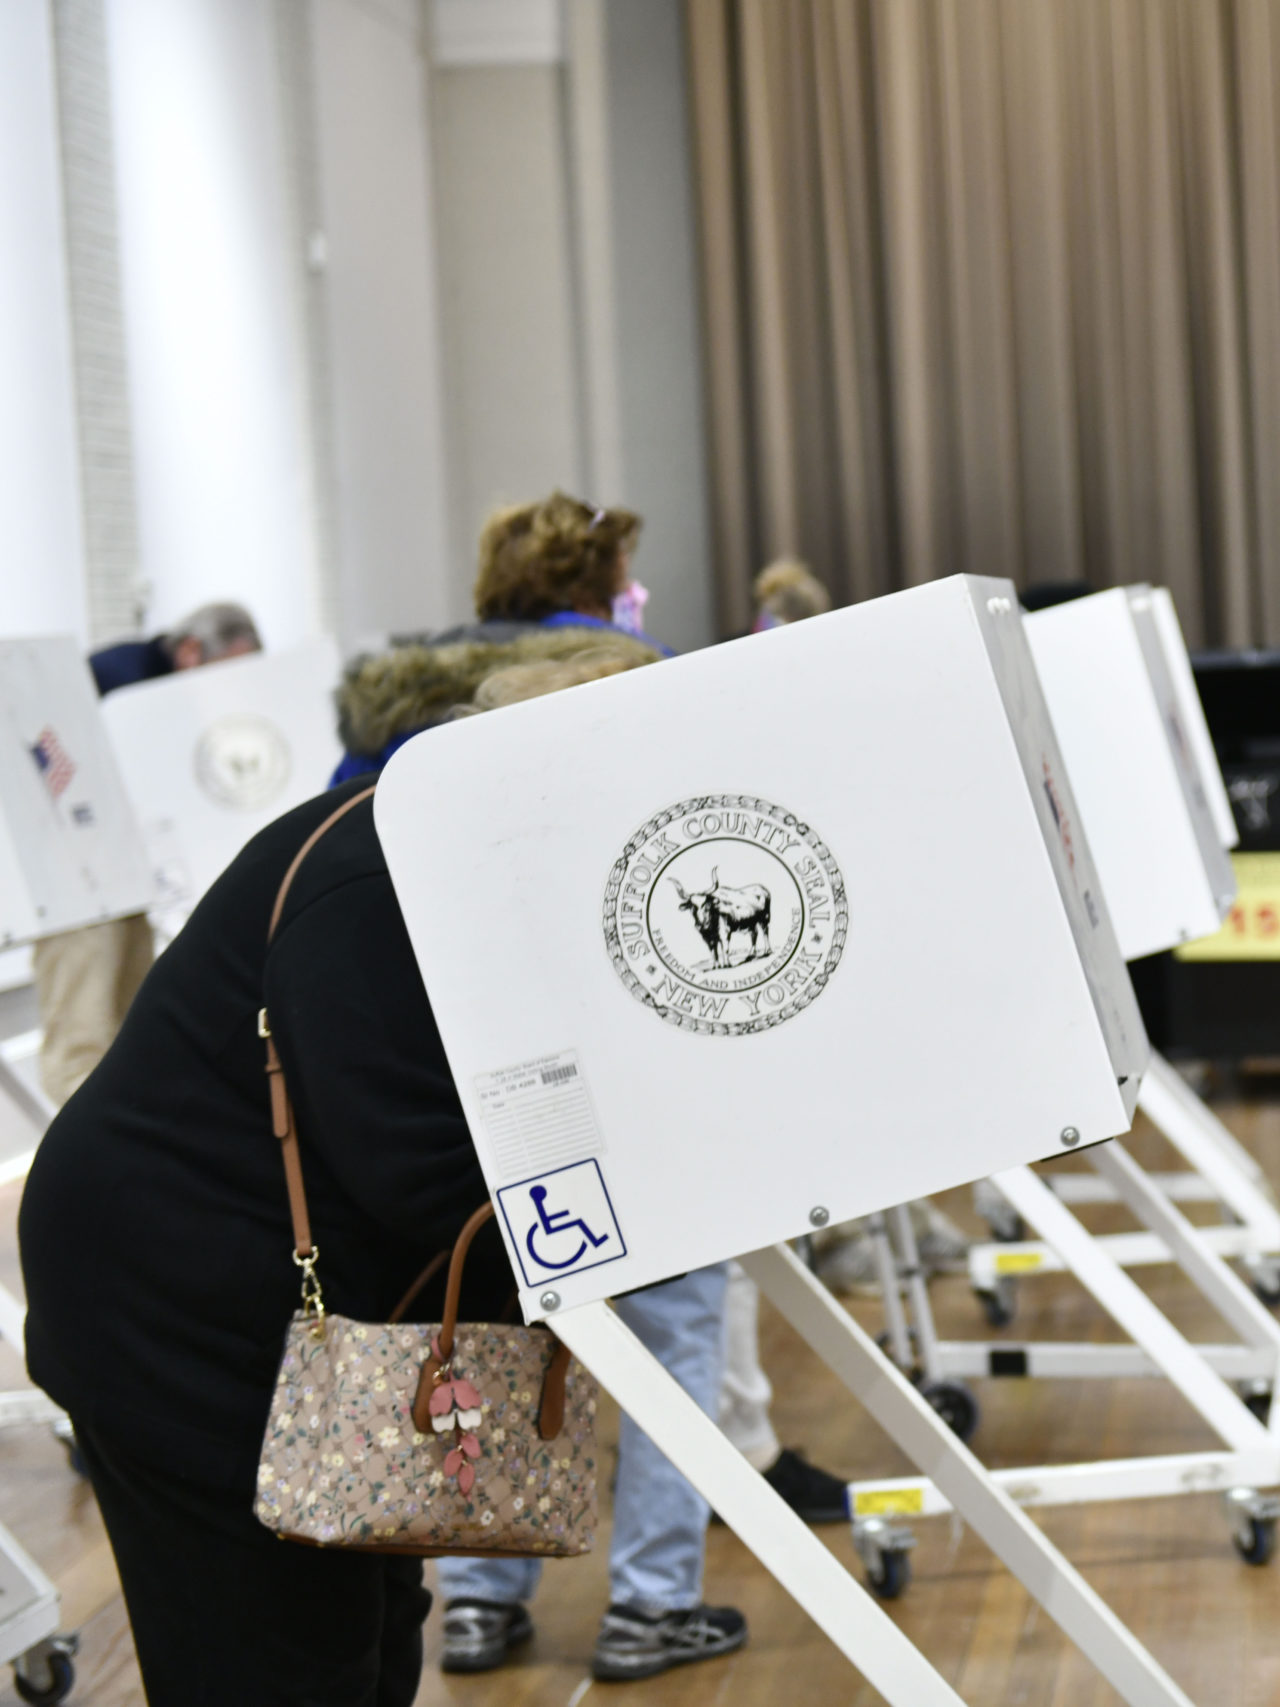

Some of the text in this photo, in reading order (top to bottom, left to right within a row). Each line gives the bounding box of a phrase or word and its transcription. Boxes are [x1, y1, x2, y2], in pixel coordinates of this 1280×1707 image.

[620, 812, 831, 961] SUFFOLK COUNTY SEAL
[652, 907, 801, 990] FREEDOM AND INDEPENDENCE
[652, 947, 823, 1020] NEW YORK
